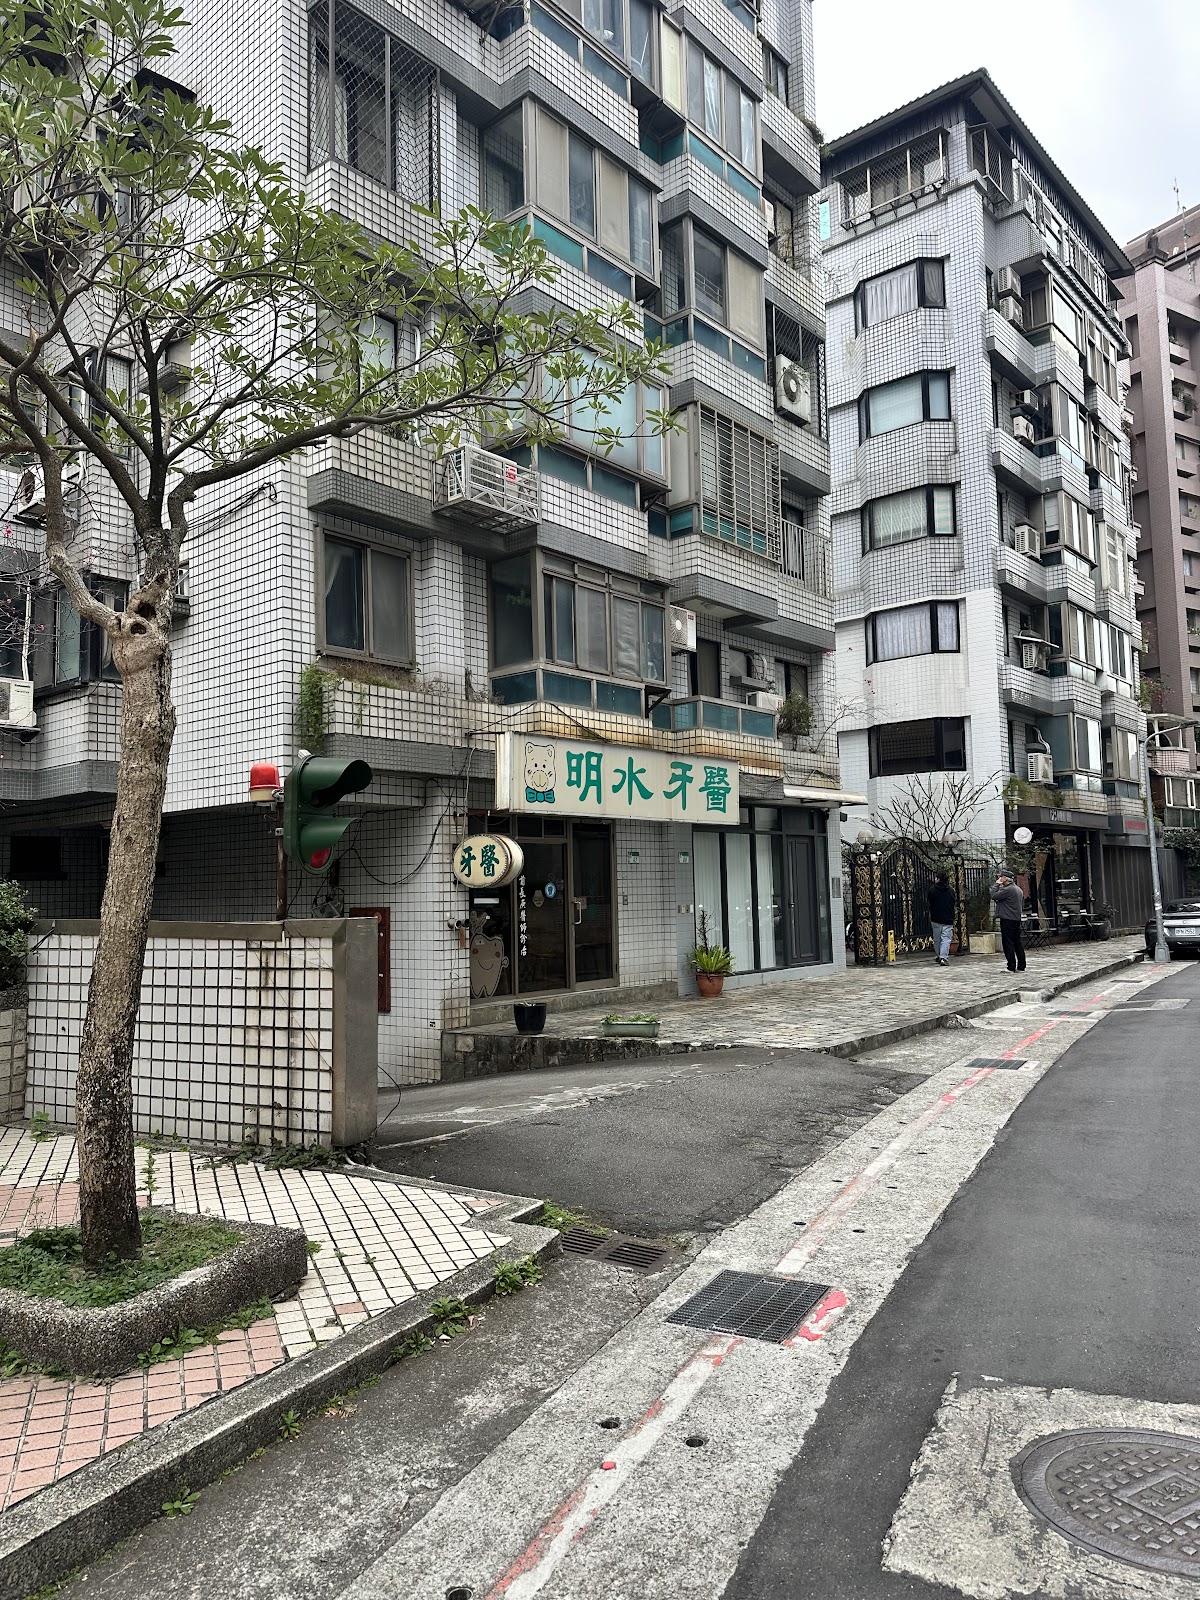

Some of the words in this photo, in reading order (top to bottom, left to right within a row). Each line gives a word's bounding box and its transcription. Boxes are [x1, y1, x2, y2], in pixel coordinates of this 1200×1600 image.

[566, 751, 732, 813] 明水牙醫
[460, 845, 500, 878] 牙醫
